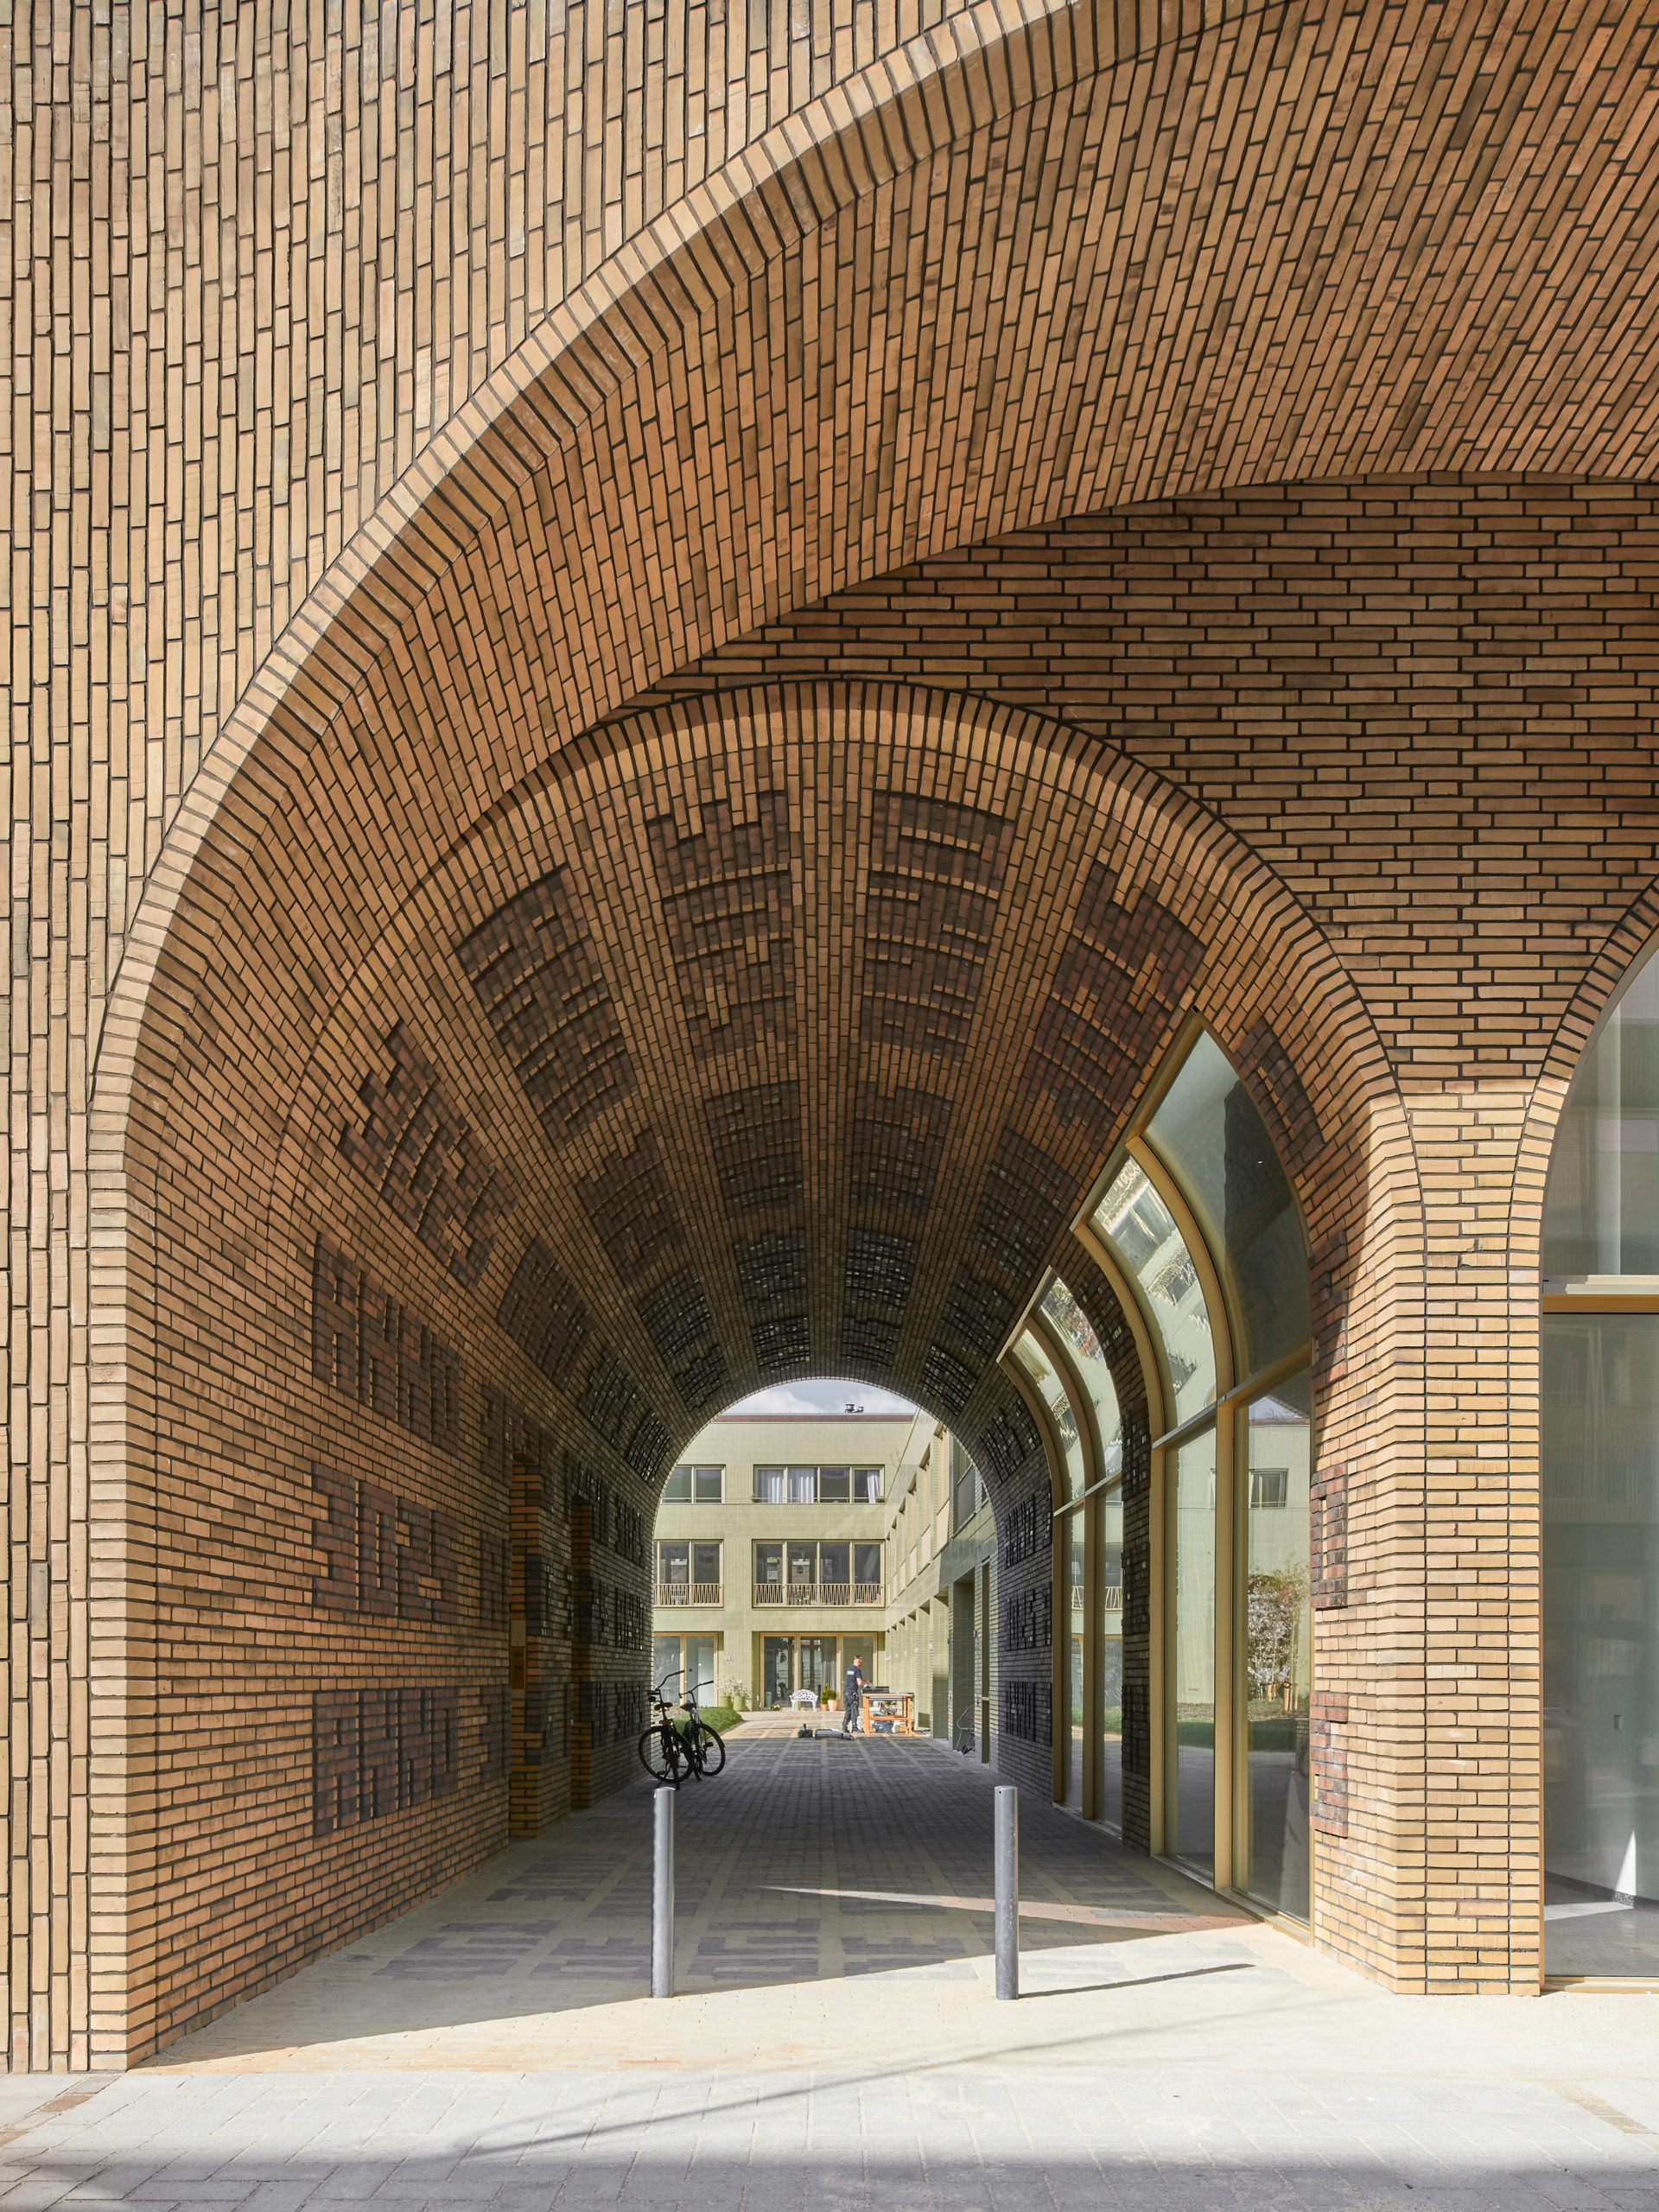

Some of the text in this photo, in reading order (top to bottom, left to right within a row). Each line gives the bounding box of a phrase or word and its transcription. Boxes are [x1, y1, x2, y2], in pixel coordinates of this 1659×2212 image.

[454, 861, 639, 1152] ANNO
[644, 788, 798, 1062] 3025
[861, 791, 1014, 1062] ANNO
[1017, 858, 1205, 1153] 3025
[335, 1020, 518, 1295] 3025
[312, 1230, 461, 1457] ANNO
[312, 1460, 456, 1624] 3025
[312, 1688, 456, 1838] ANNO
